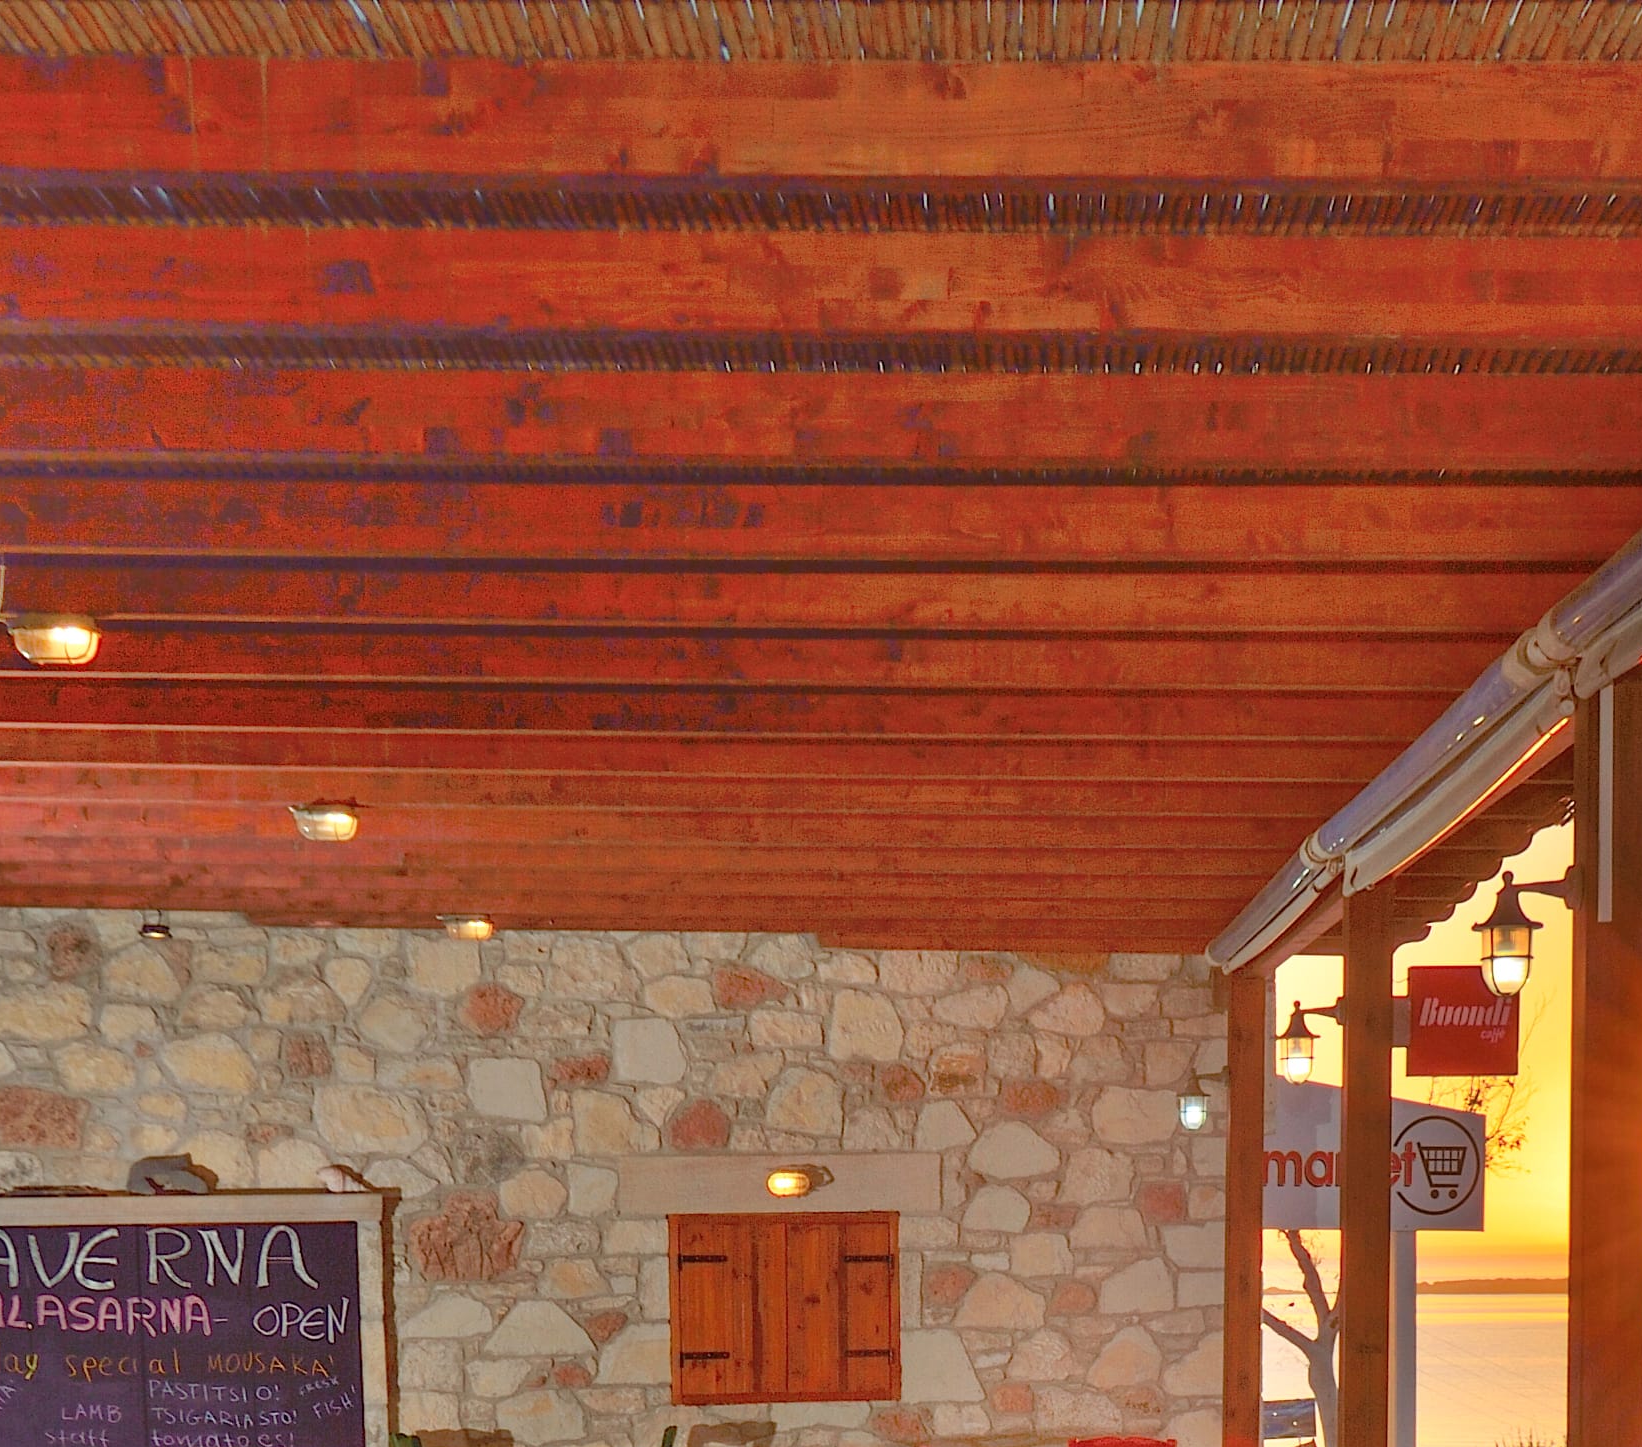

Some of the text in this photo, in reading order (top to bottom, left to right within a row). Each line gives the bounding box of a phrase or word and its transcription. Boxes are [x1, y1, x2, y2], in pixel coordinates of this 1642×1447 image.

[1262, 1141, 1417, 1188] mat
[252, 1296, 349, 1343] OPEN
[65, 1349, 181, 1383] special
[60, 1403, 122, 1423] LAMB
